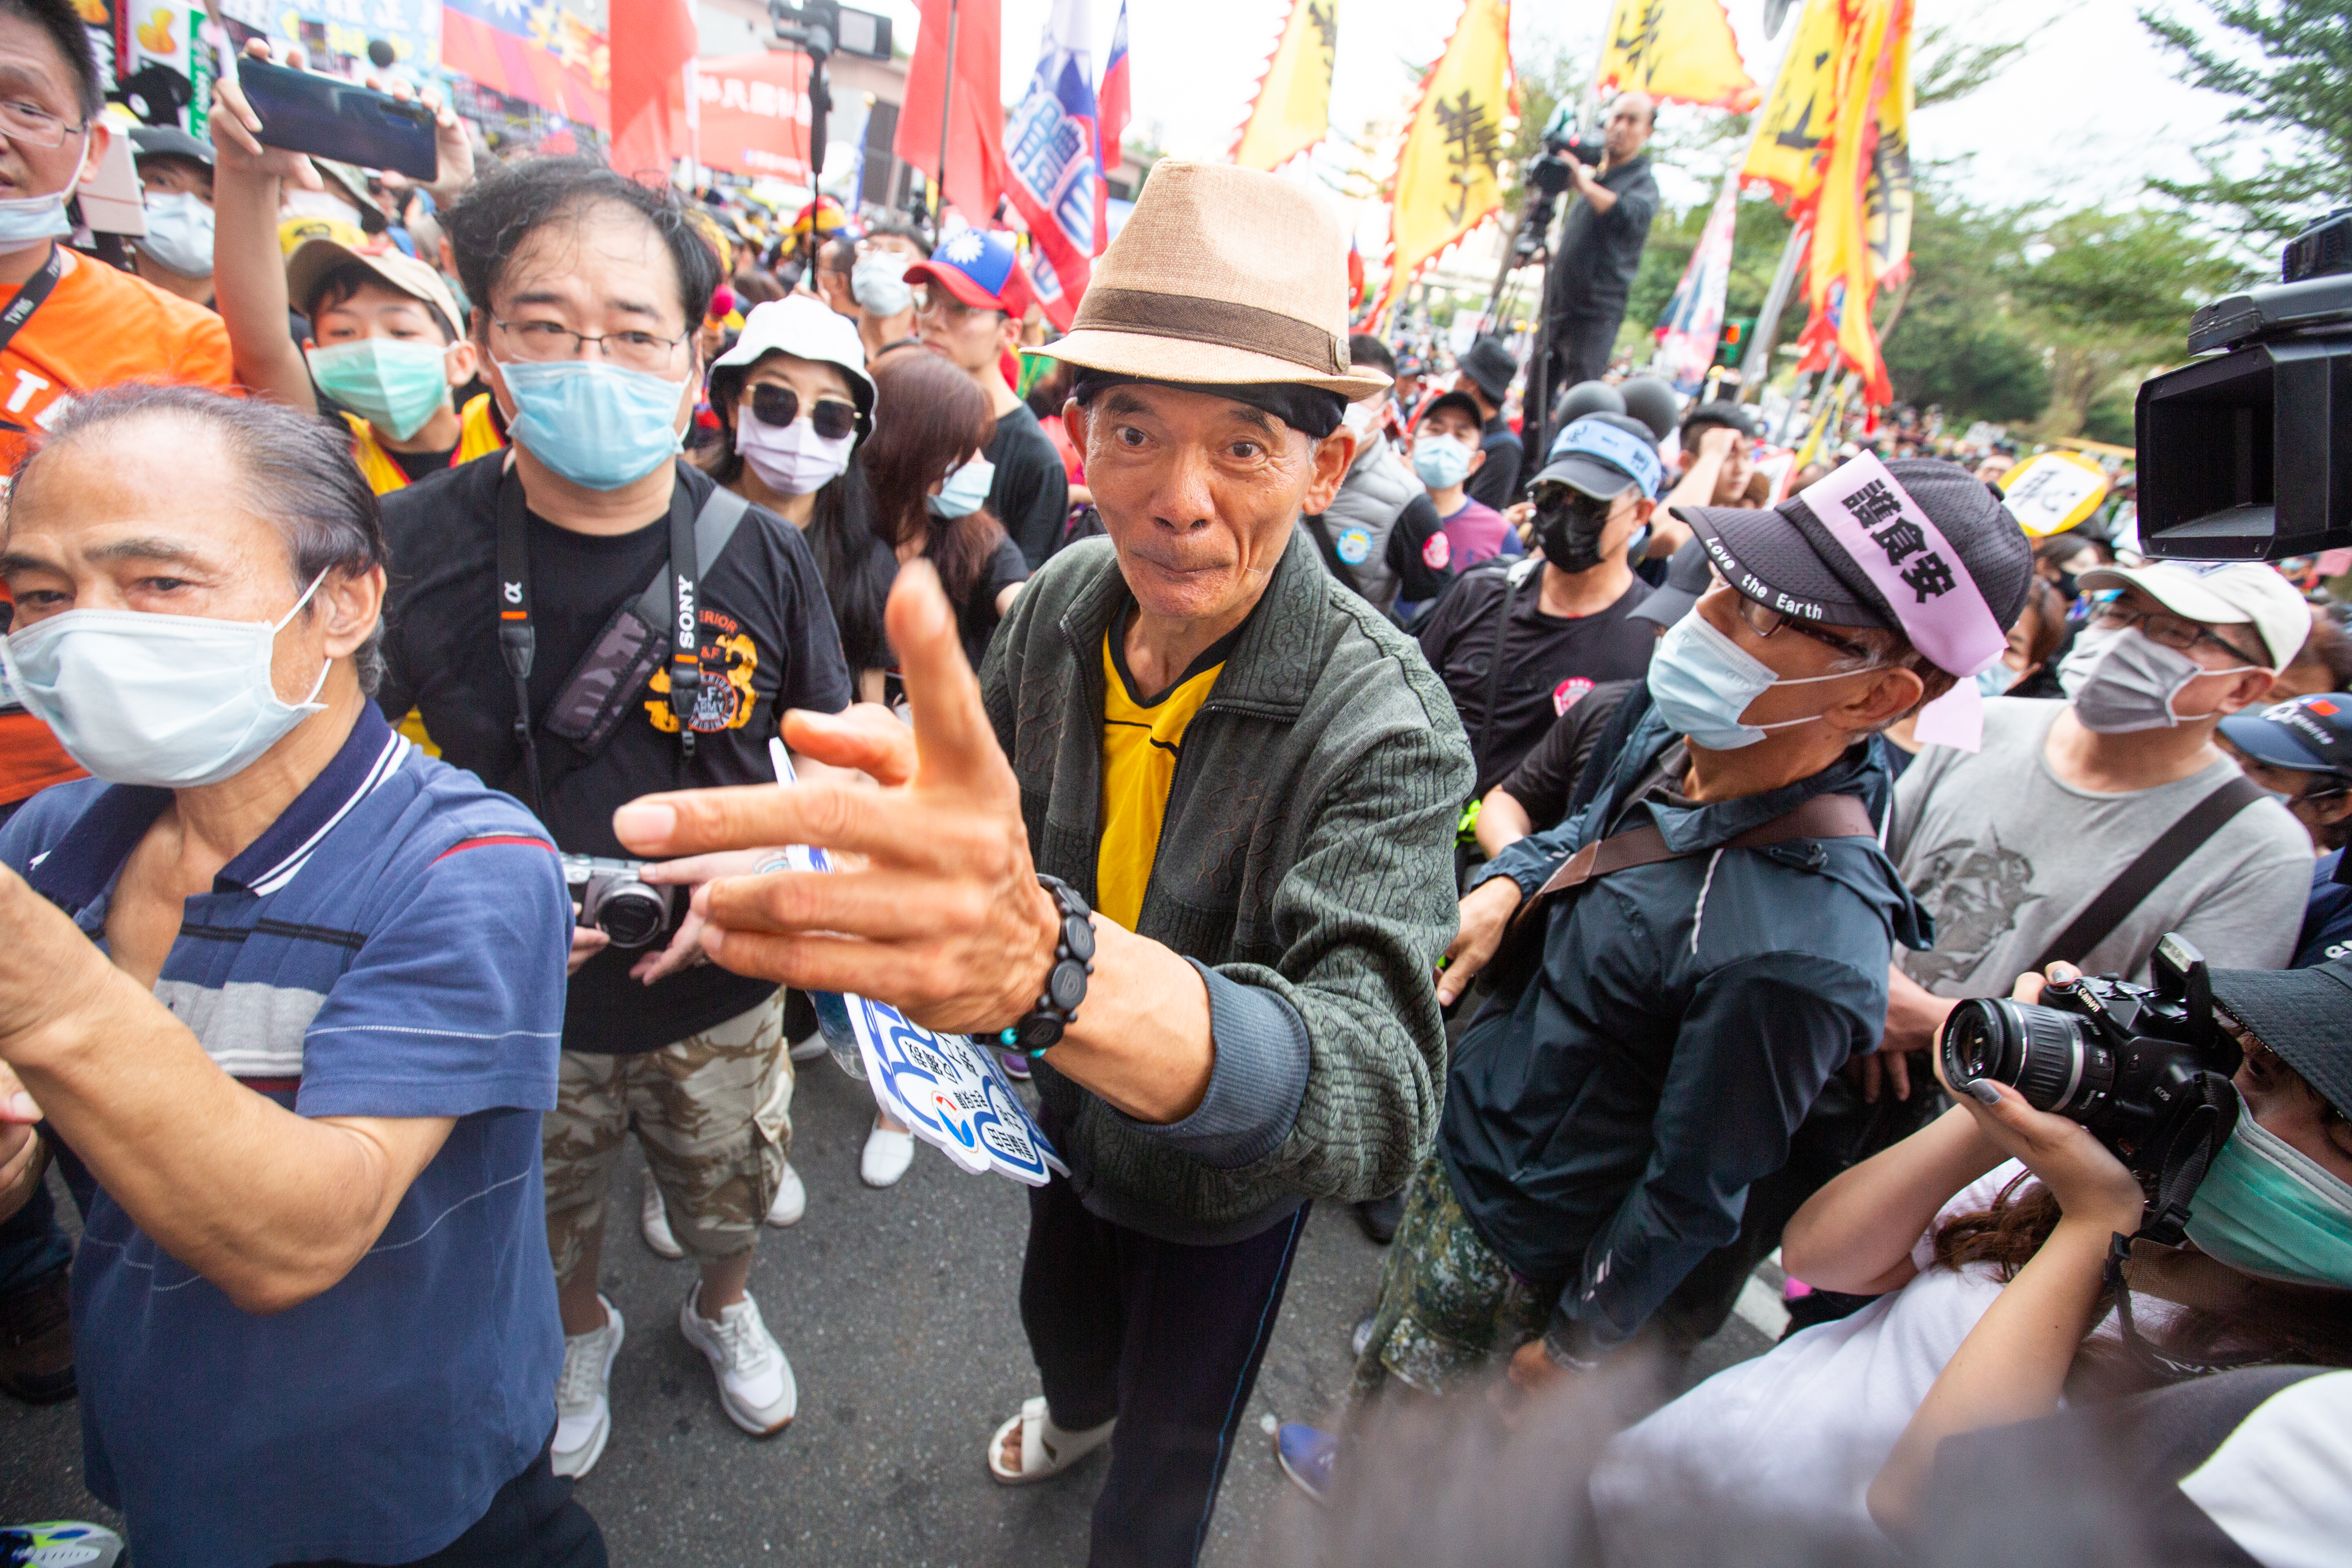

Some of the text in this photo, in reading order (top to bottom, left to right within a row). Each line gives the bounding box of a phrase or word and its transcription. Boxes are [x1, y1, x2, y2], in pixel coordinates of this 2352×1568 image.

[1841, 478, 1957, 603] 護食安
[1706, 537, 1823, 620] Love the Earth
[678, 574, 694, 649] SONY
[693, 701, 725, 714] ARMY
[2077, 987, 2101, 1013] Canon
[904, 1040, 959, 1085] 反獨裁
[952, 1089, 989, 1110] 老年保障
[985, 1125, 1034, 1160] 言論自由
